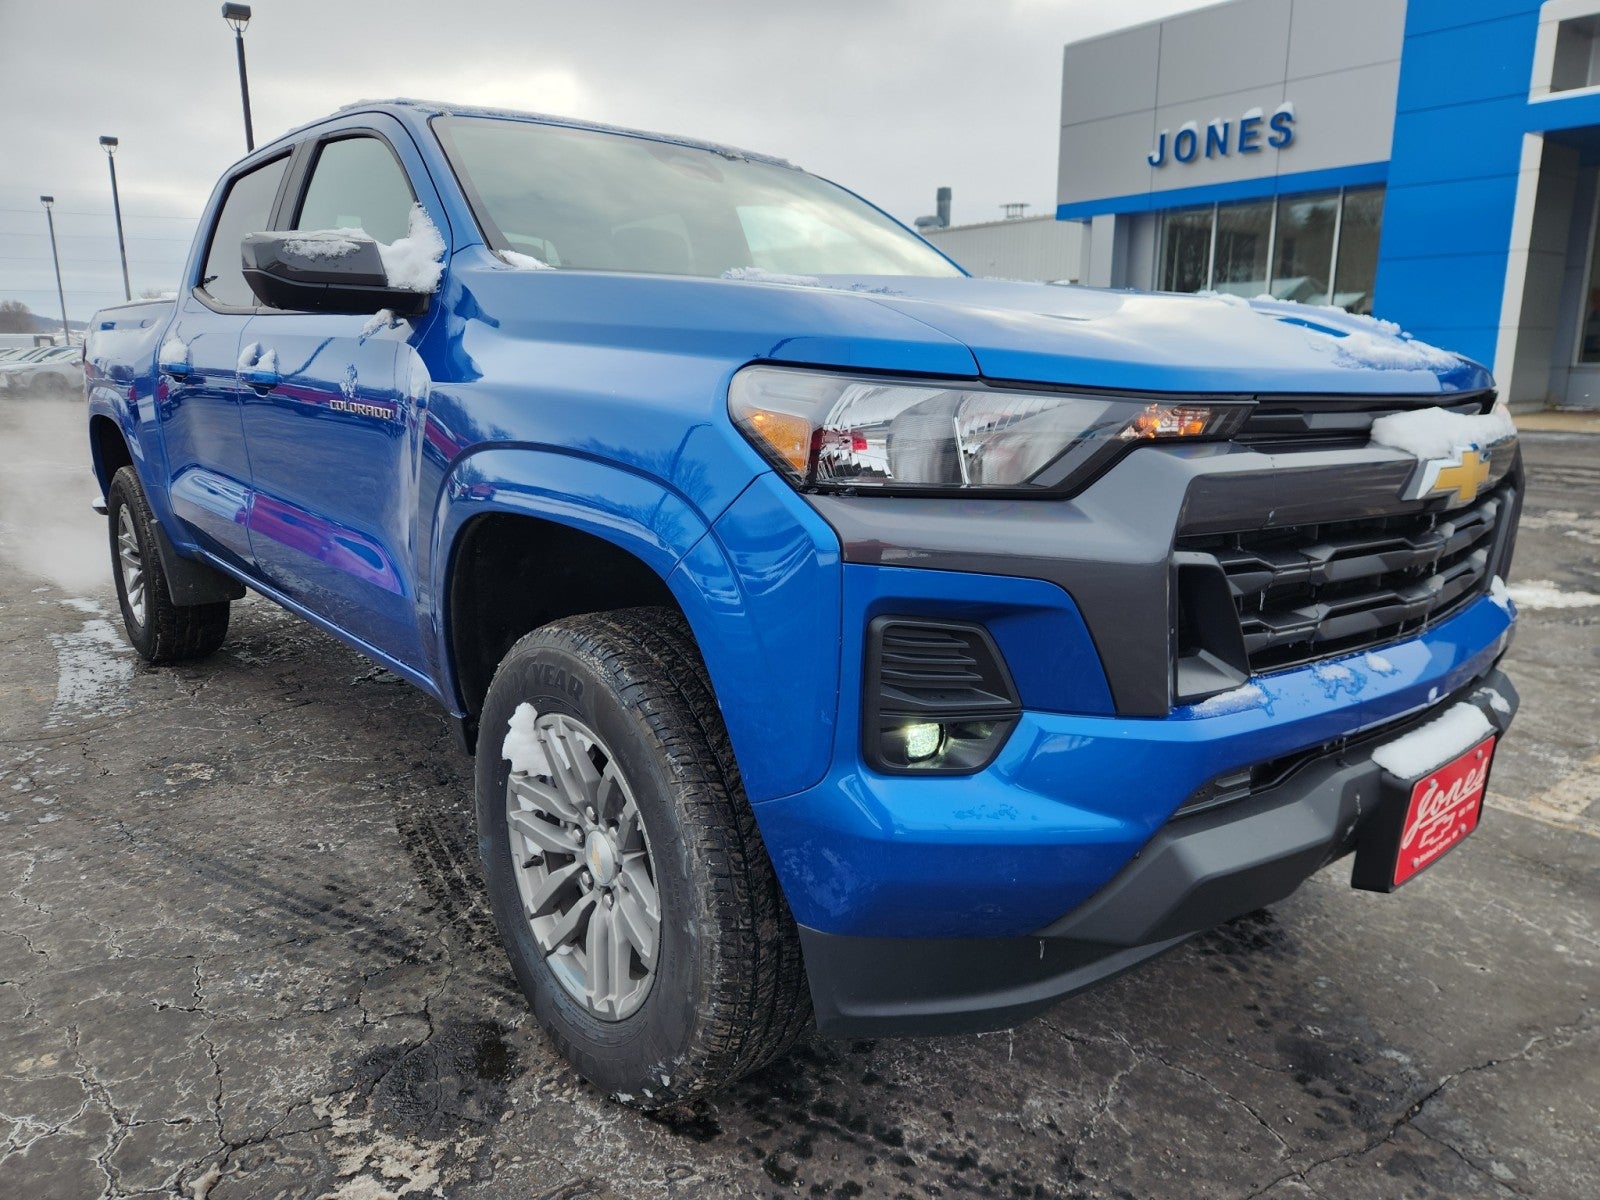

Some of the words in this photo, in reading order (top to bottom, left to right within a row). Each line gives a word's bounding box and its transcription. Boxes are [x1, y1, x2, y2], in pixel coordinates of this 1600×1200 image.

[1147, 111, 1294, 167] JONES
[329, 399, 393, 420] COLORADO
[1401, 756, 1489, 850] Jones
